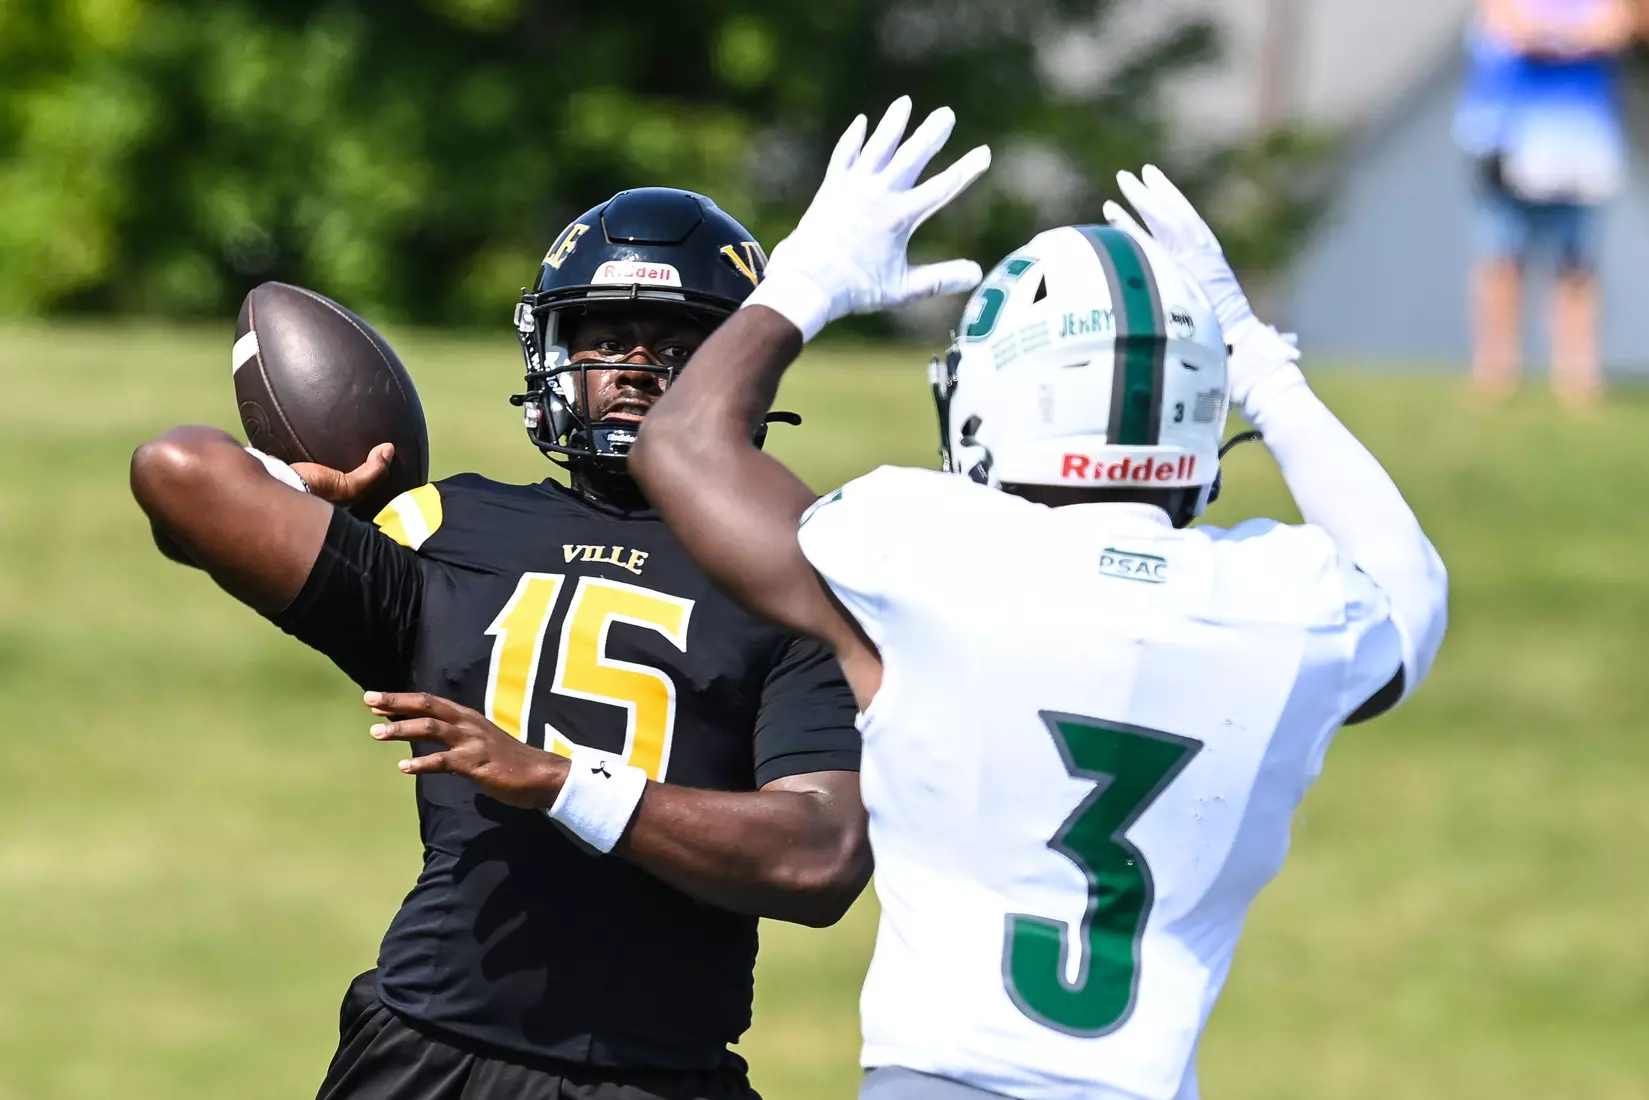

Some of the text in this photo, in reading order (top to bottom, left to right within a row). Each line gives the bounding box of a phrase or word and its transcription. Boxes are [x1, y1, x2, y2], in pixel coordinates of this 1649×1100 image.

[604, 264, 671, 281] Rdell
[1060, 452, 1197, 482] Riddell
[562, 544, 649, 575] VILLE
[1100, 555, 1168, 580] PSAC
[484, 571, 696, 784] 15
[1001, 708, 1205, 1038] 3
